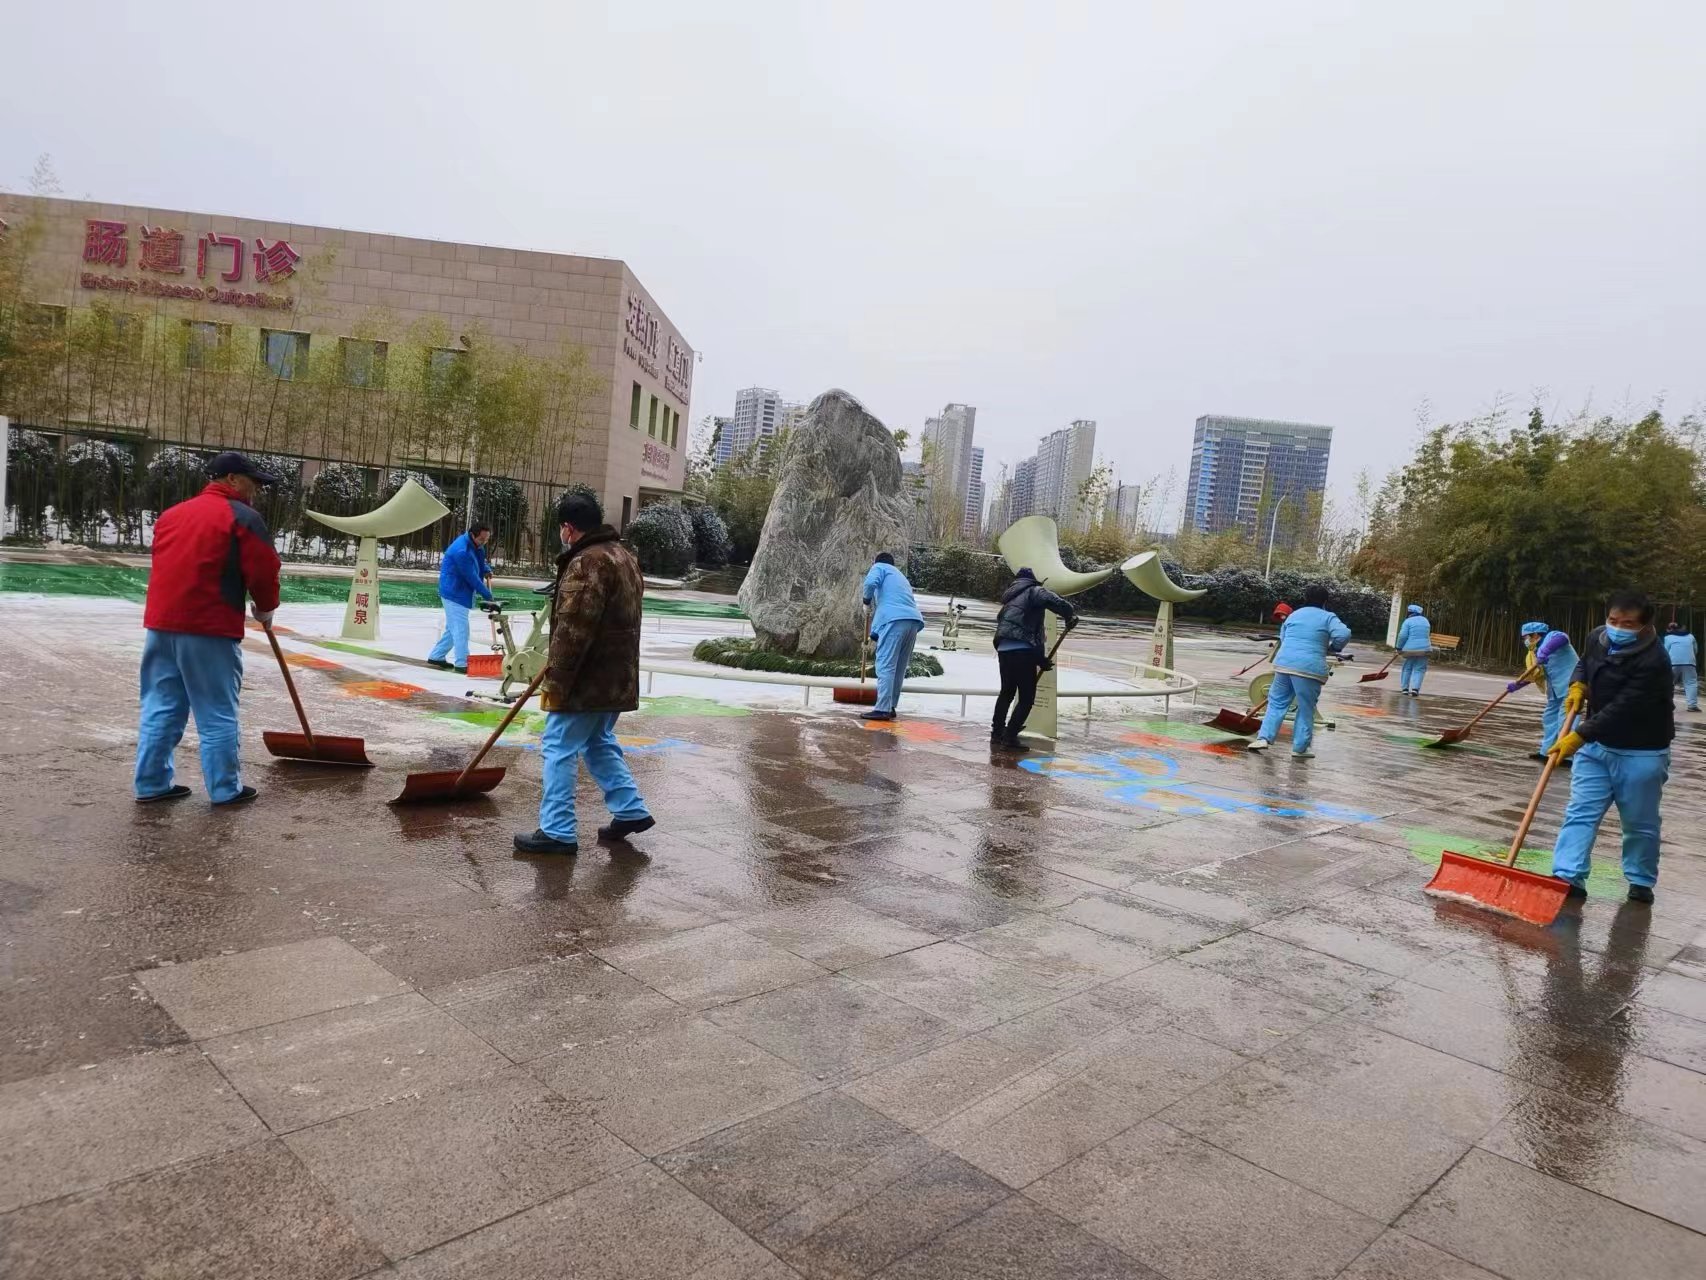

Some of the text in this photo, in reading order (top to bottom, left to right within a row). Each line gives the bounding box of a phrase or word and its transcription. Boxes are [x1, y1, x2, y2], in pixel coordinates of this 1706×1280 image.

[82, 219, 300, 285] 肠道门诊
[353, 592, 369, 625] 喊泉
